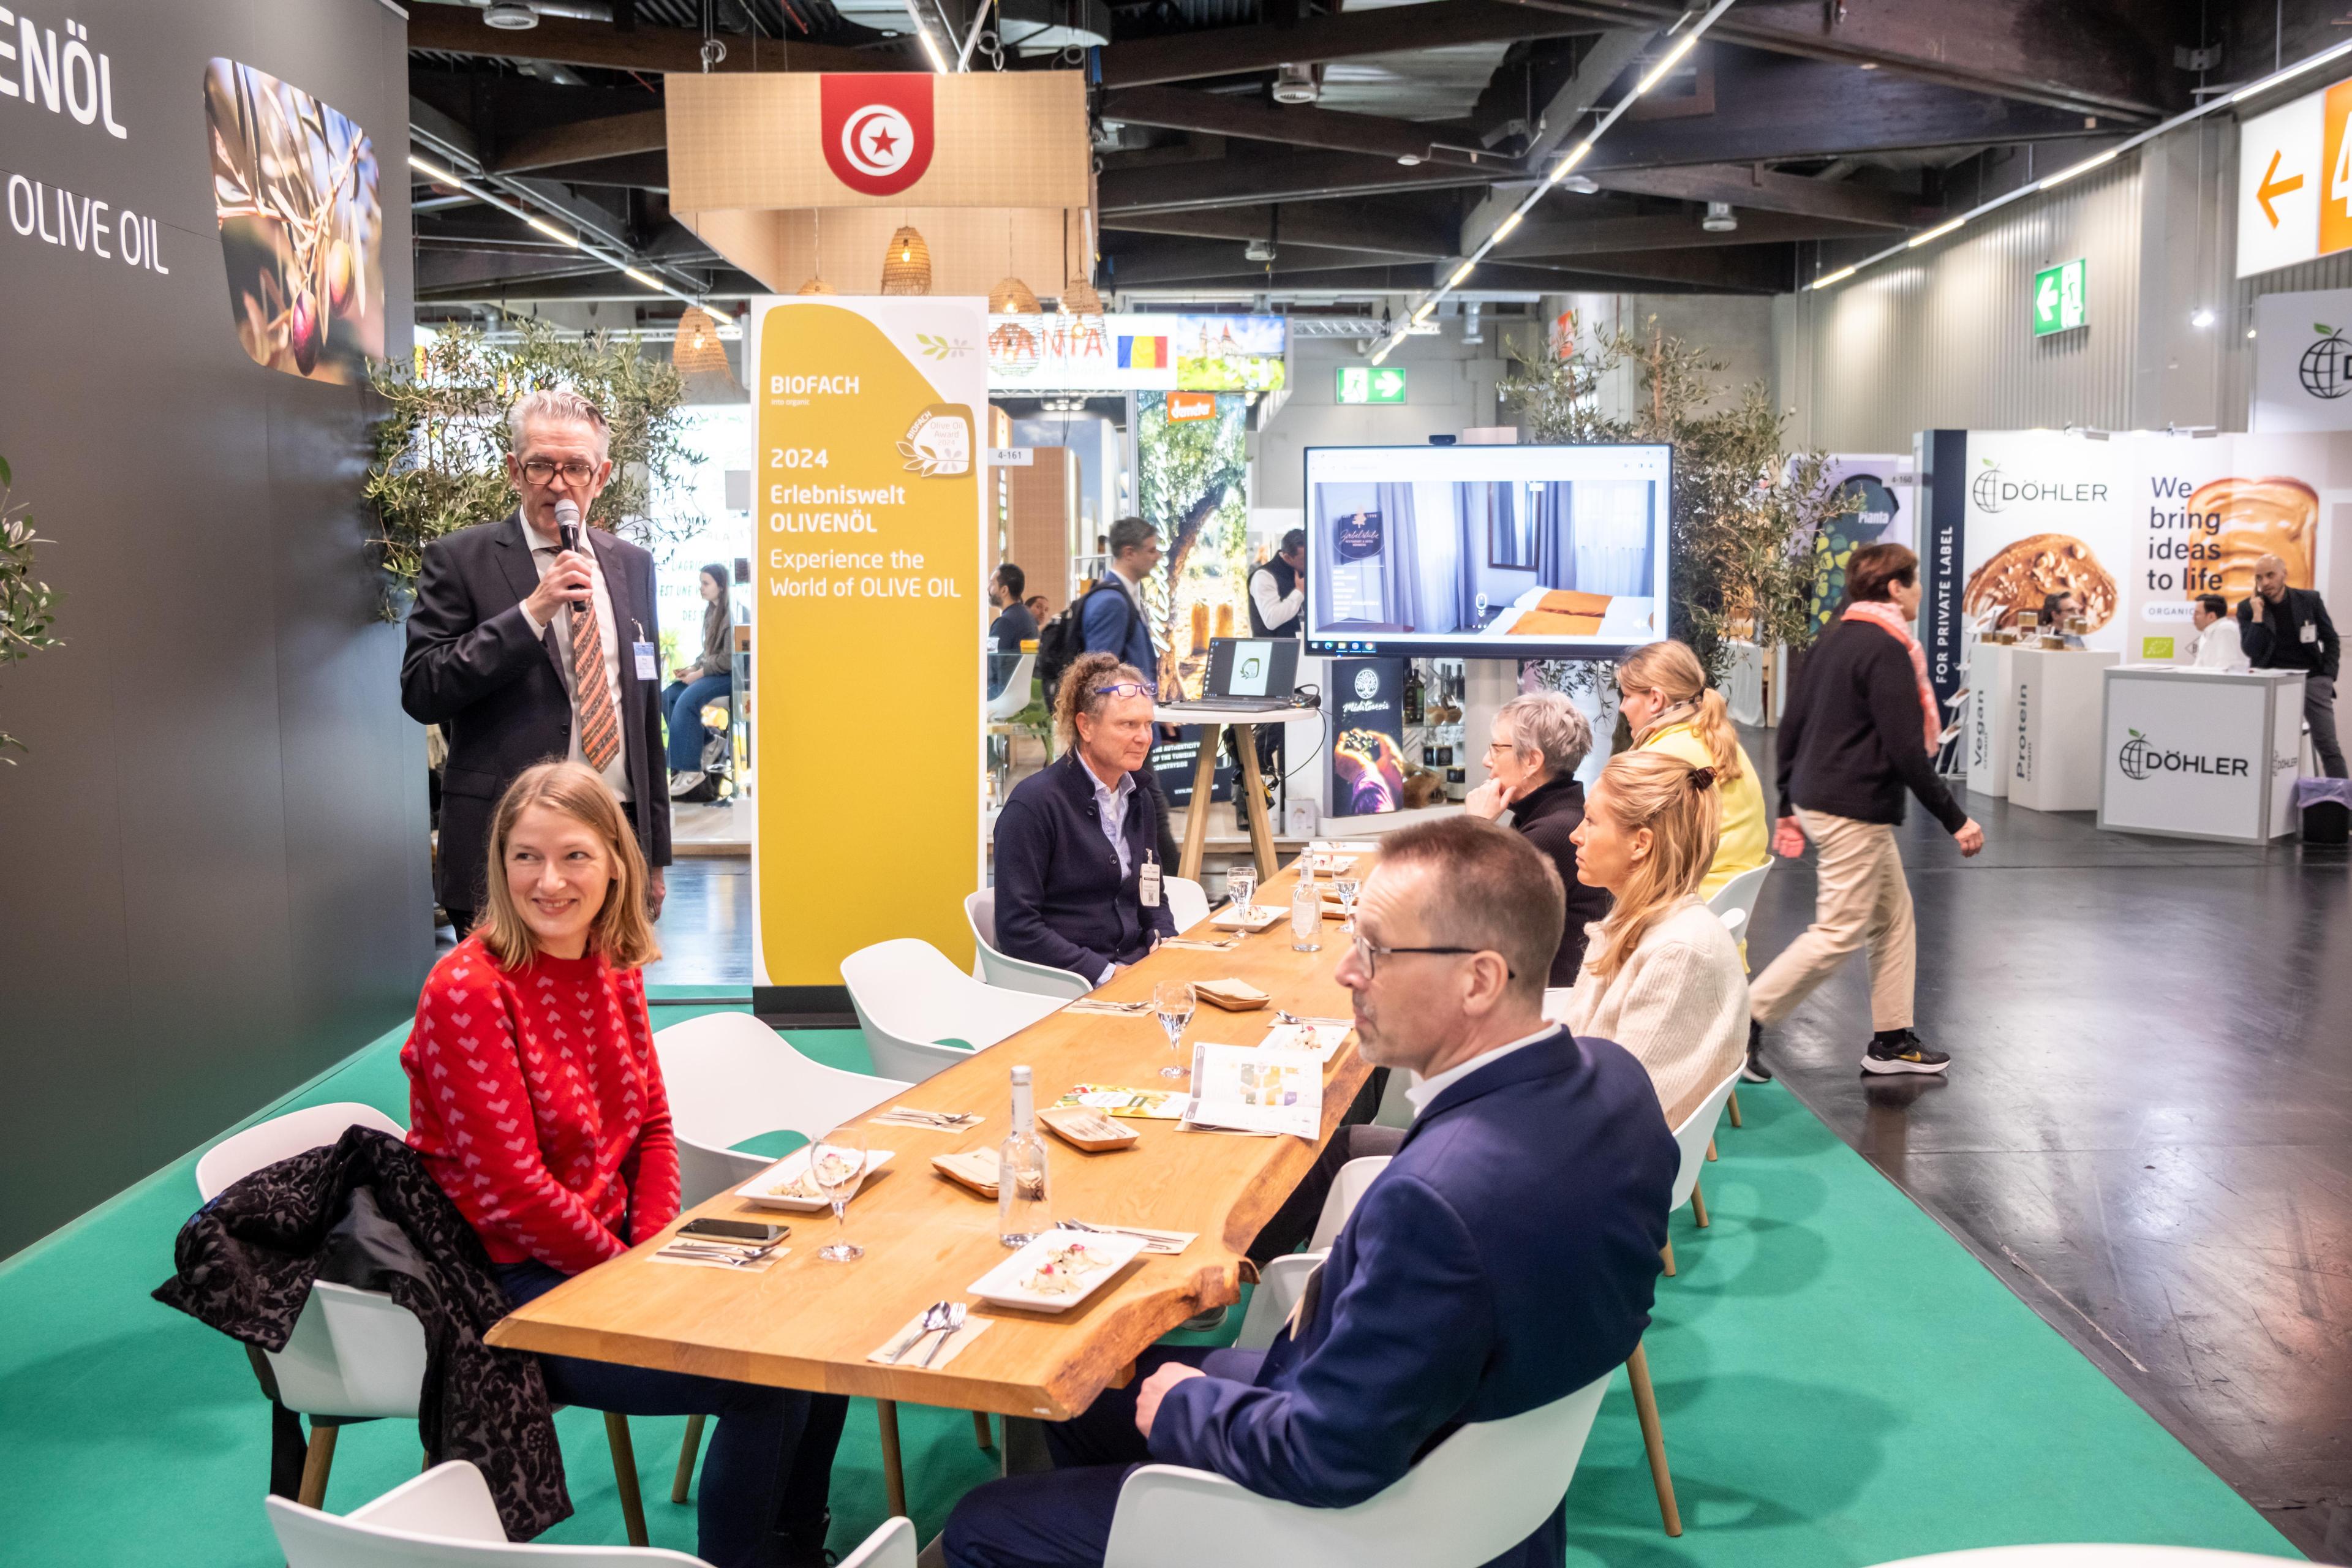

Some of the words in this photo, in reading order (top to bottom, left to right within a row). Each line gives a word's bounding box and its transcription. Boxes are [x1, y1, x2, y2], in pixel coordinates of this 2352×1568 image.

[9, 174, 111, 259] OLIVE
[120, 210, 169, 274] OIL
[771, 375, 860, 394] BIOFACH
[1170, 399, 1211, 420] demeter
[907, 410, 932, 440] BIOFACH
[930, 421, 951, 430] Olive
[952, 421, 963, 430] Oil
[771, 449, 829, 469] 2024
[998, 451, 1022, 460] 4-161
[771, 484, 906, 505] Erlebniswelt
[2002, 479, 2108, 502] DÖHLER
[2151, 477, 2193, 499] We
[771, 509, 878, 533] OLIVENÖL
[2150, 506, 2221, 536] bring
[1939, 525, 1953, 575] LABEL
[2149, 537, 2222, 560] ideas
[771, 549, 883, 573] Experience
[890, 549, 925, 569] the
[770, 577, 827, 597] World
[833, 577, 855, 597] of
[861, 578, 922, 598] OLIVE
[928, 578, 962, 598] OIL
[2147, 570, 2173, 590] to
[2183, 568, 2223, 591] life
[1937, 581, 1951, 647] PRIVATE
[1936, 651, 1949, 684] FOR
[1974, 690, 1985, 766] Vegan
[2016, 685, 2027, 778] Protein
[1163, 741, 1200, 752] AUTHENTICITY
[1172, 750, 1197, 760] TUNISIAN
[2146, 750, 2248, 777] DÖHLER
